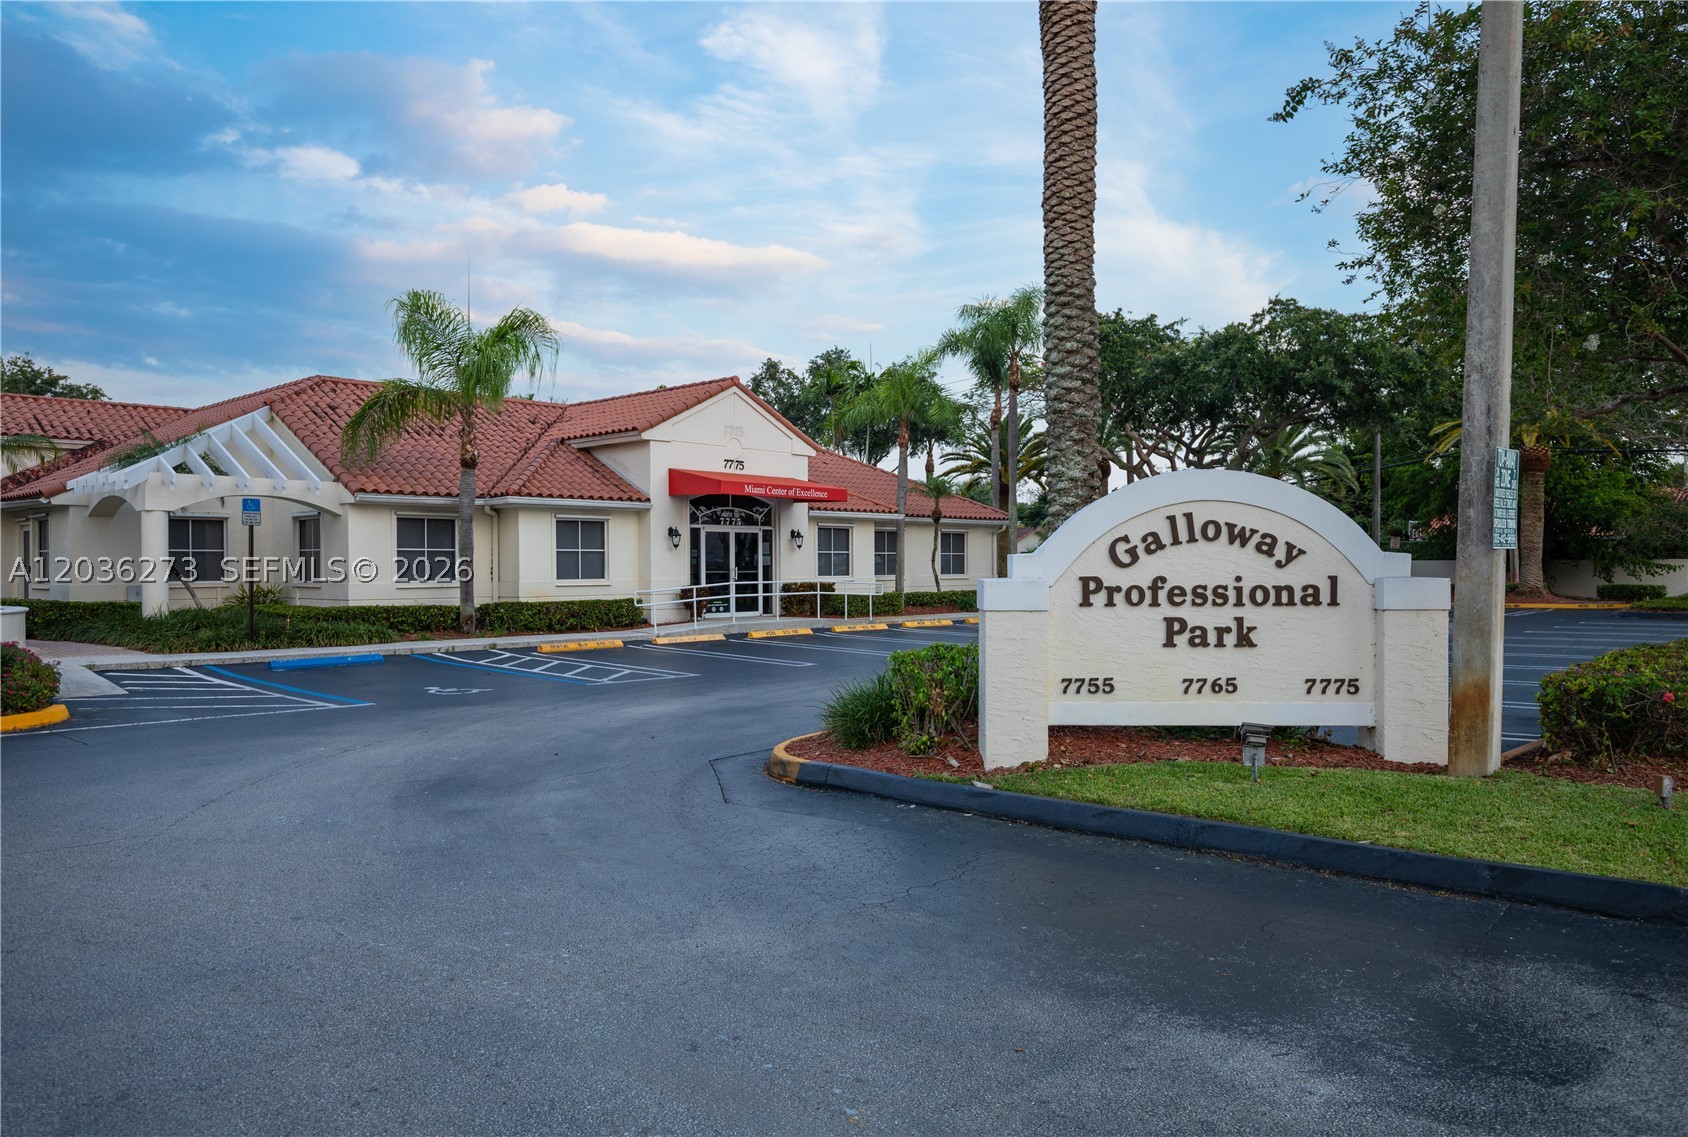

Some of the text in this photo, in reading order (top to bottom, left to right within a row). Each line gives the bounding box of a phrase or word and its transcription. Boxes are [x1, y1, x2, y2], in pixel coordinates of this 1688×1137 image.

[723, 458, 745, 471] 7775
[744, 484, 828, 498] Miami Center of Excellence
[720, 517, 742, 526] 7775
[1108, 512, 1307, 569] Galloway
[1078, 575, 1341, 608] Professional
[1162, 616, 1259, 648] Park
[1060, 677, 1361, 696] 7755 7765 7775
